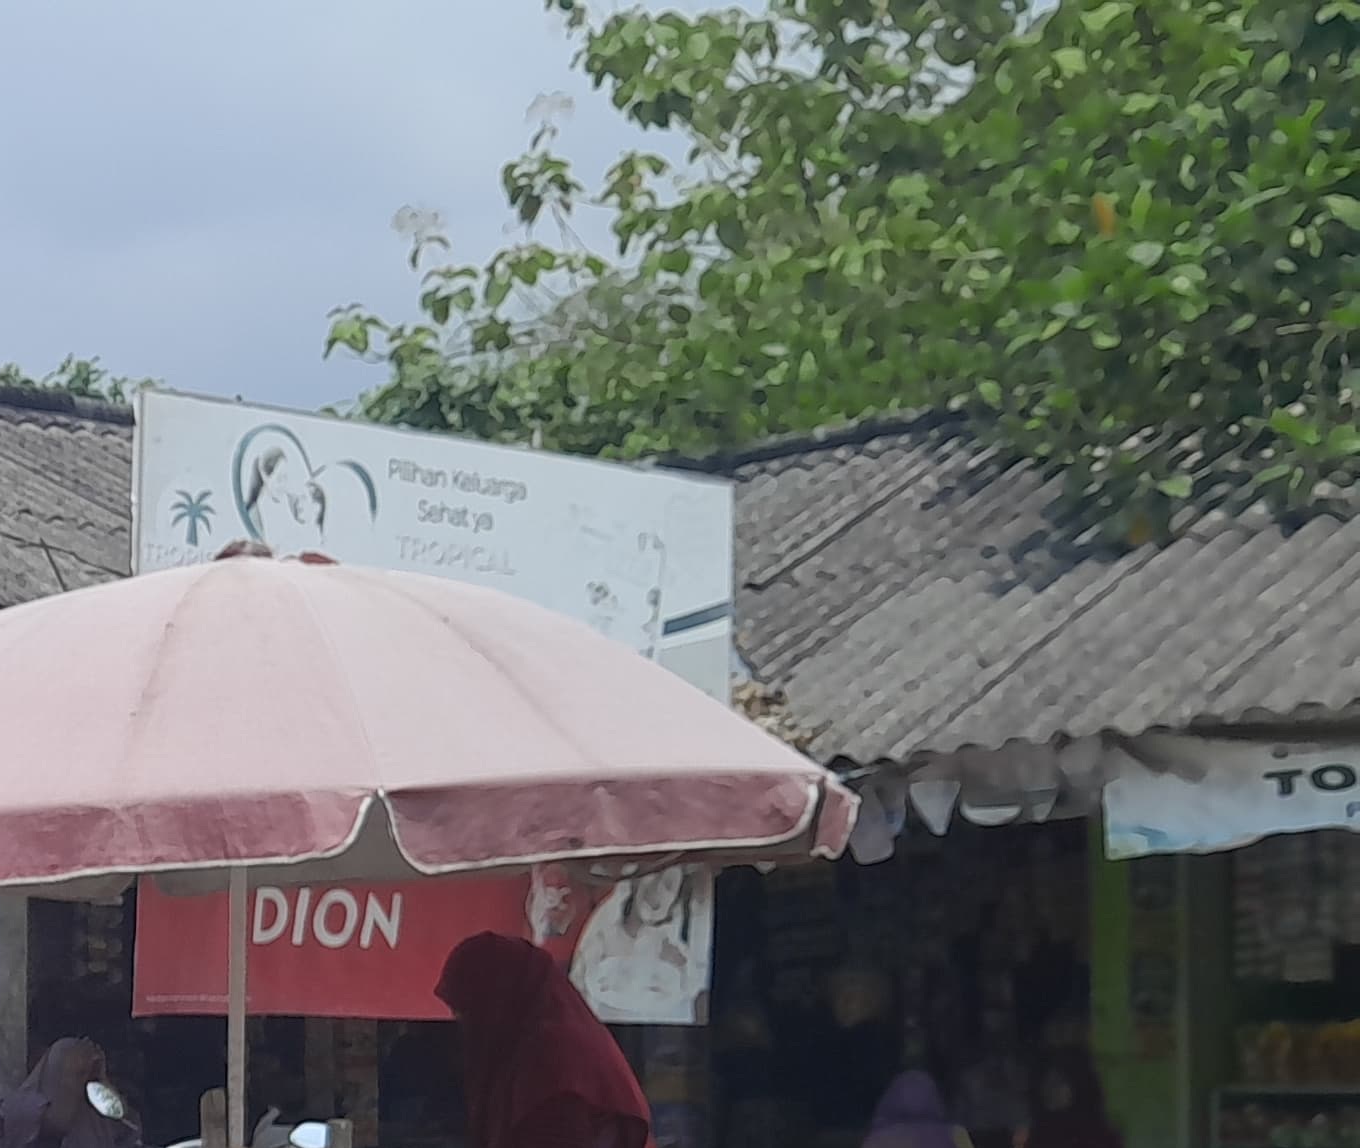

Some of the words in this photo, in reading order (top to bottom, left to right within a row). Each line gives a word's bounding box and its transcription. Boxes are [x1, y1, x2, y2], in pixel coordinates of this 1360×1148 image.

[388, 458, 447, 488] Pilihan
[452, 469, 527, 503] Keluarga
[417, 499, 469, 528] Sehat
[252, 886, 403, 949] DION
